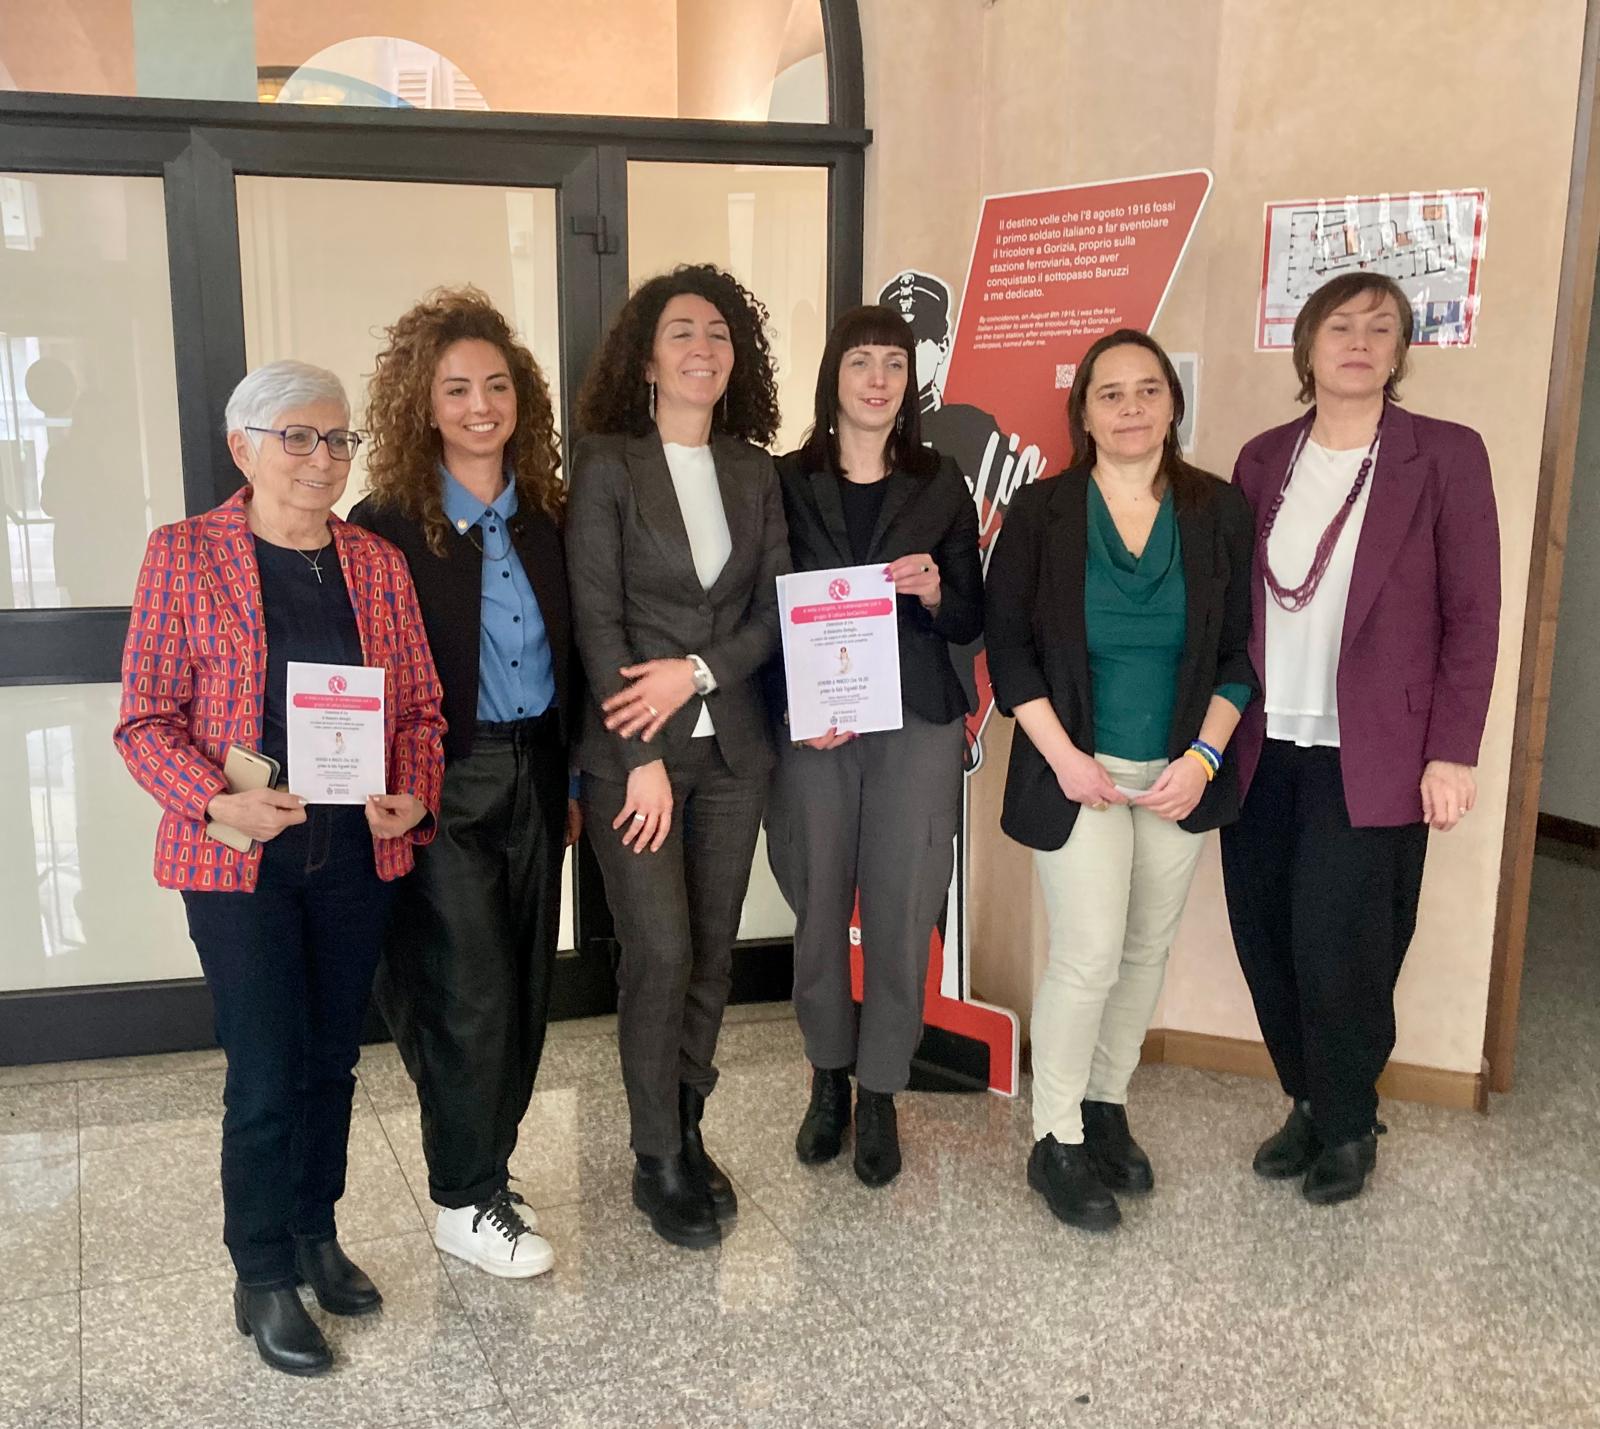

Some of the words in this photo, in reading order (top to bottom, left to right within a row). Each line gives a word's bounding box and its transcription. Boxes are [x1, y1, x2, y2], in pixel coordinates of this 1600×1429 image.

[1006, 218, 1038, 230] destino
[1040, 213, 1060, 226] volle
[1062, 211, 1079, 223] che
[1081, 209, 1091, 221] l'8
[1093, 207, 1125, 221] agosto
[1128, 203, 1151, 215] 1916
[1153, 200, 1176, 213] fossi
[996, 234, 1002, 245] il
[1003, 233, 1028, 246] primo
[1029, 228, 1061, 241] soldato
[1063, 225, 1096, 238] italiano
[1097, 225, 1103, 234] a
[1105, 221, 1118, 233] far
[1120, 217, 1169, 232] sventolare
[993, 248, 998, 259] il
[1000, 246, 1035, 259] tricolore
[1036, 246, 1042, 255] a
[1043, 242, 1077, 254] Gorizia,
[1079, 238, 1112, 253] proprio
[1114, 235, 1136, 248] sulla
[990, 262, 1025, 273] stazione
[1027, 256, 1072, 271] ferroviaria,
[1074, 254, 1098, 267] dopo
[1100, 252, 1119, 263] aver
[986, 274, 1036, 288] conquistato
[1038, 272, 1043, 283] il
[1044, 269, 1093, 283] sottopasso
[1095, 264, 1129, 278] Baruzzi
[983, 292, 989, 301] a
[990, 292, 1004, 301] me
[1005, 288, 1044, 300] dedicato.
[986, 314, 1020, 323] coincidence,
[1029, 312, 1049, 321] August
[1080, 309, 1093, 317] was
[1103, 306, 1116, 315] first
[994, 323, 1013, 331] soldier
[1019, 322, 1034, 330] wave
[1034, 321, 1044, 329] the
[1069, 318, 1080, 327] flag
[1081, 318, 1087, 326] in
[1109, 316, 1122, 326] just
[983, 333, 992, 341] the
[992, 332, 1005, 340] train
[1025, 330, 1039, 339] after
[1039, 328, 1072, 338] conquering
[1072, 328, 1082, 336] the
[1002, 340, 1022, 348] named
[1022, 339, 1036, 347] after
